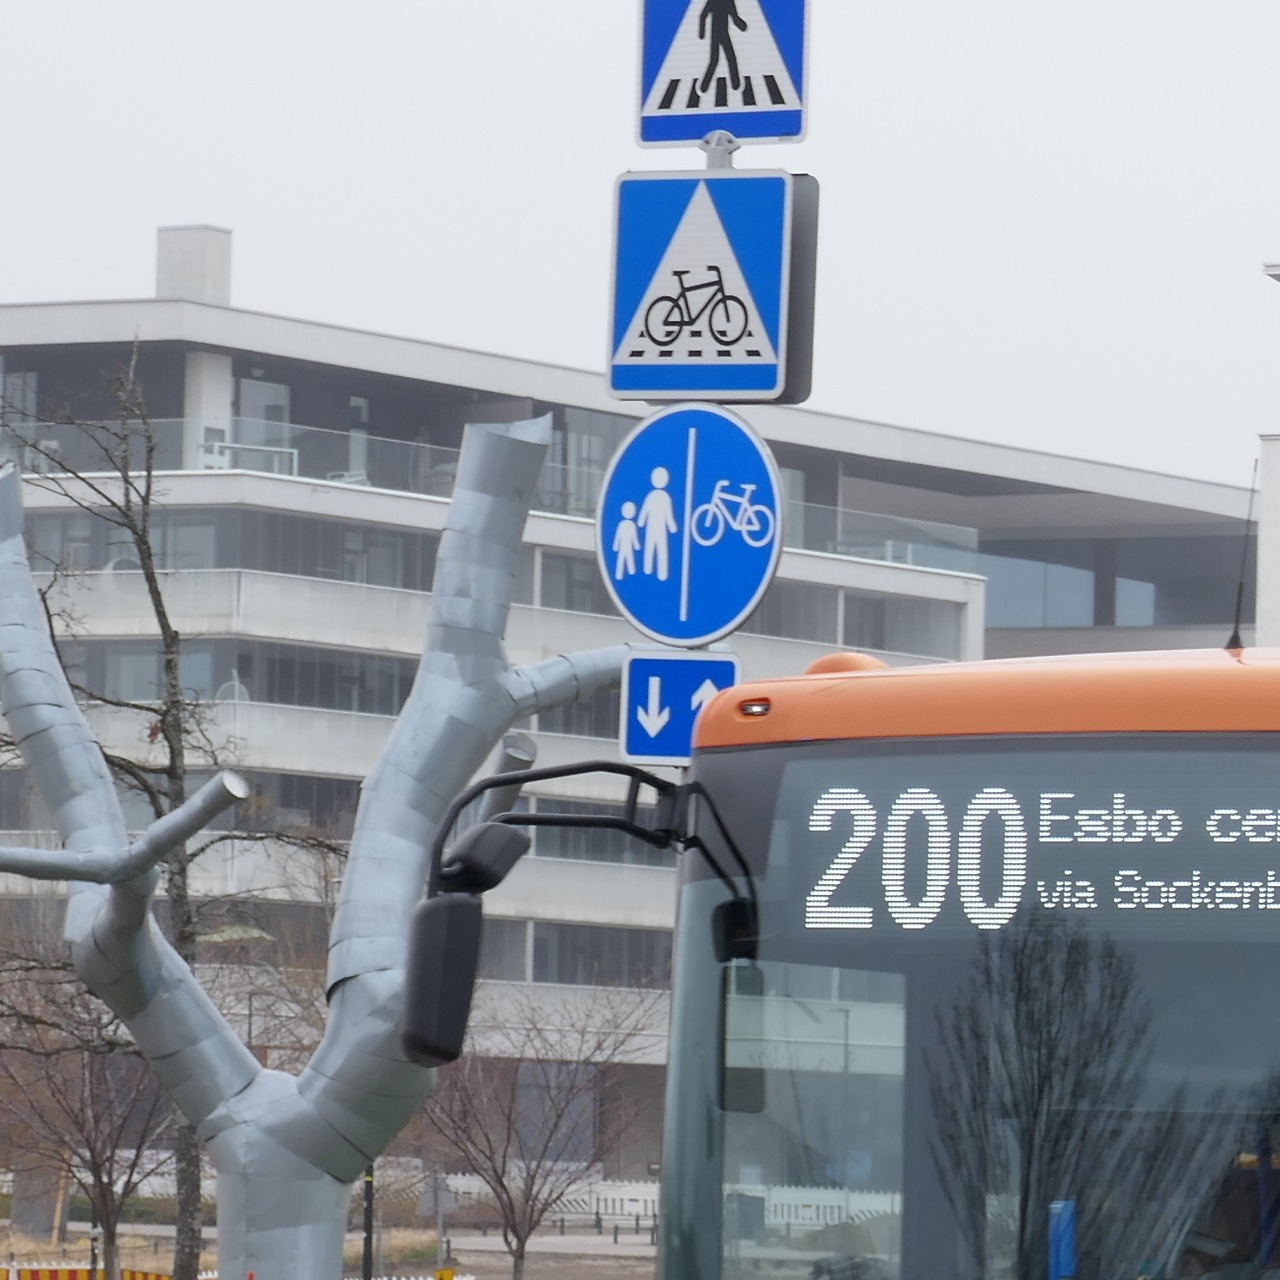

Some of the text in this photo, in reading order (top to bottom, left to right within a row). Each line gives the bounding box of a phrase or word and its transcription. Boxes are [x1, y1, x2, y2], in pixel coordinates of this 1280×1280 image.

[1038, 792, 1183, 843] Esbo
[805, 787, 1027, 930] 200
[1036, 870, 1098, 909] via
